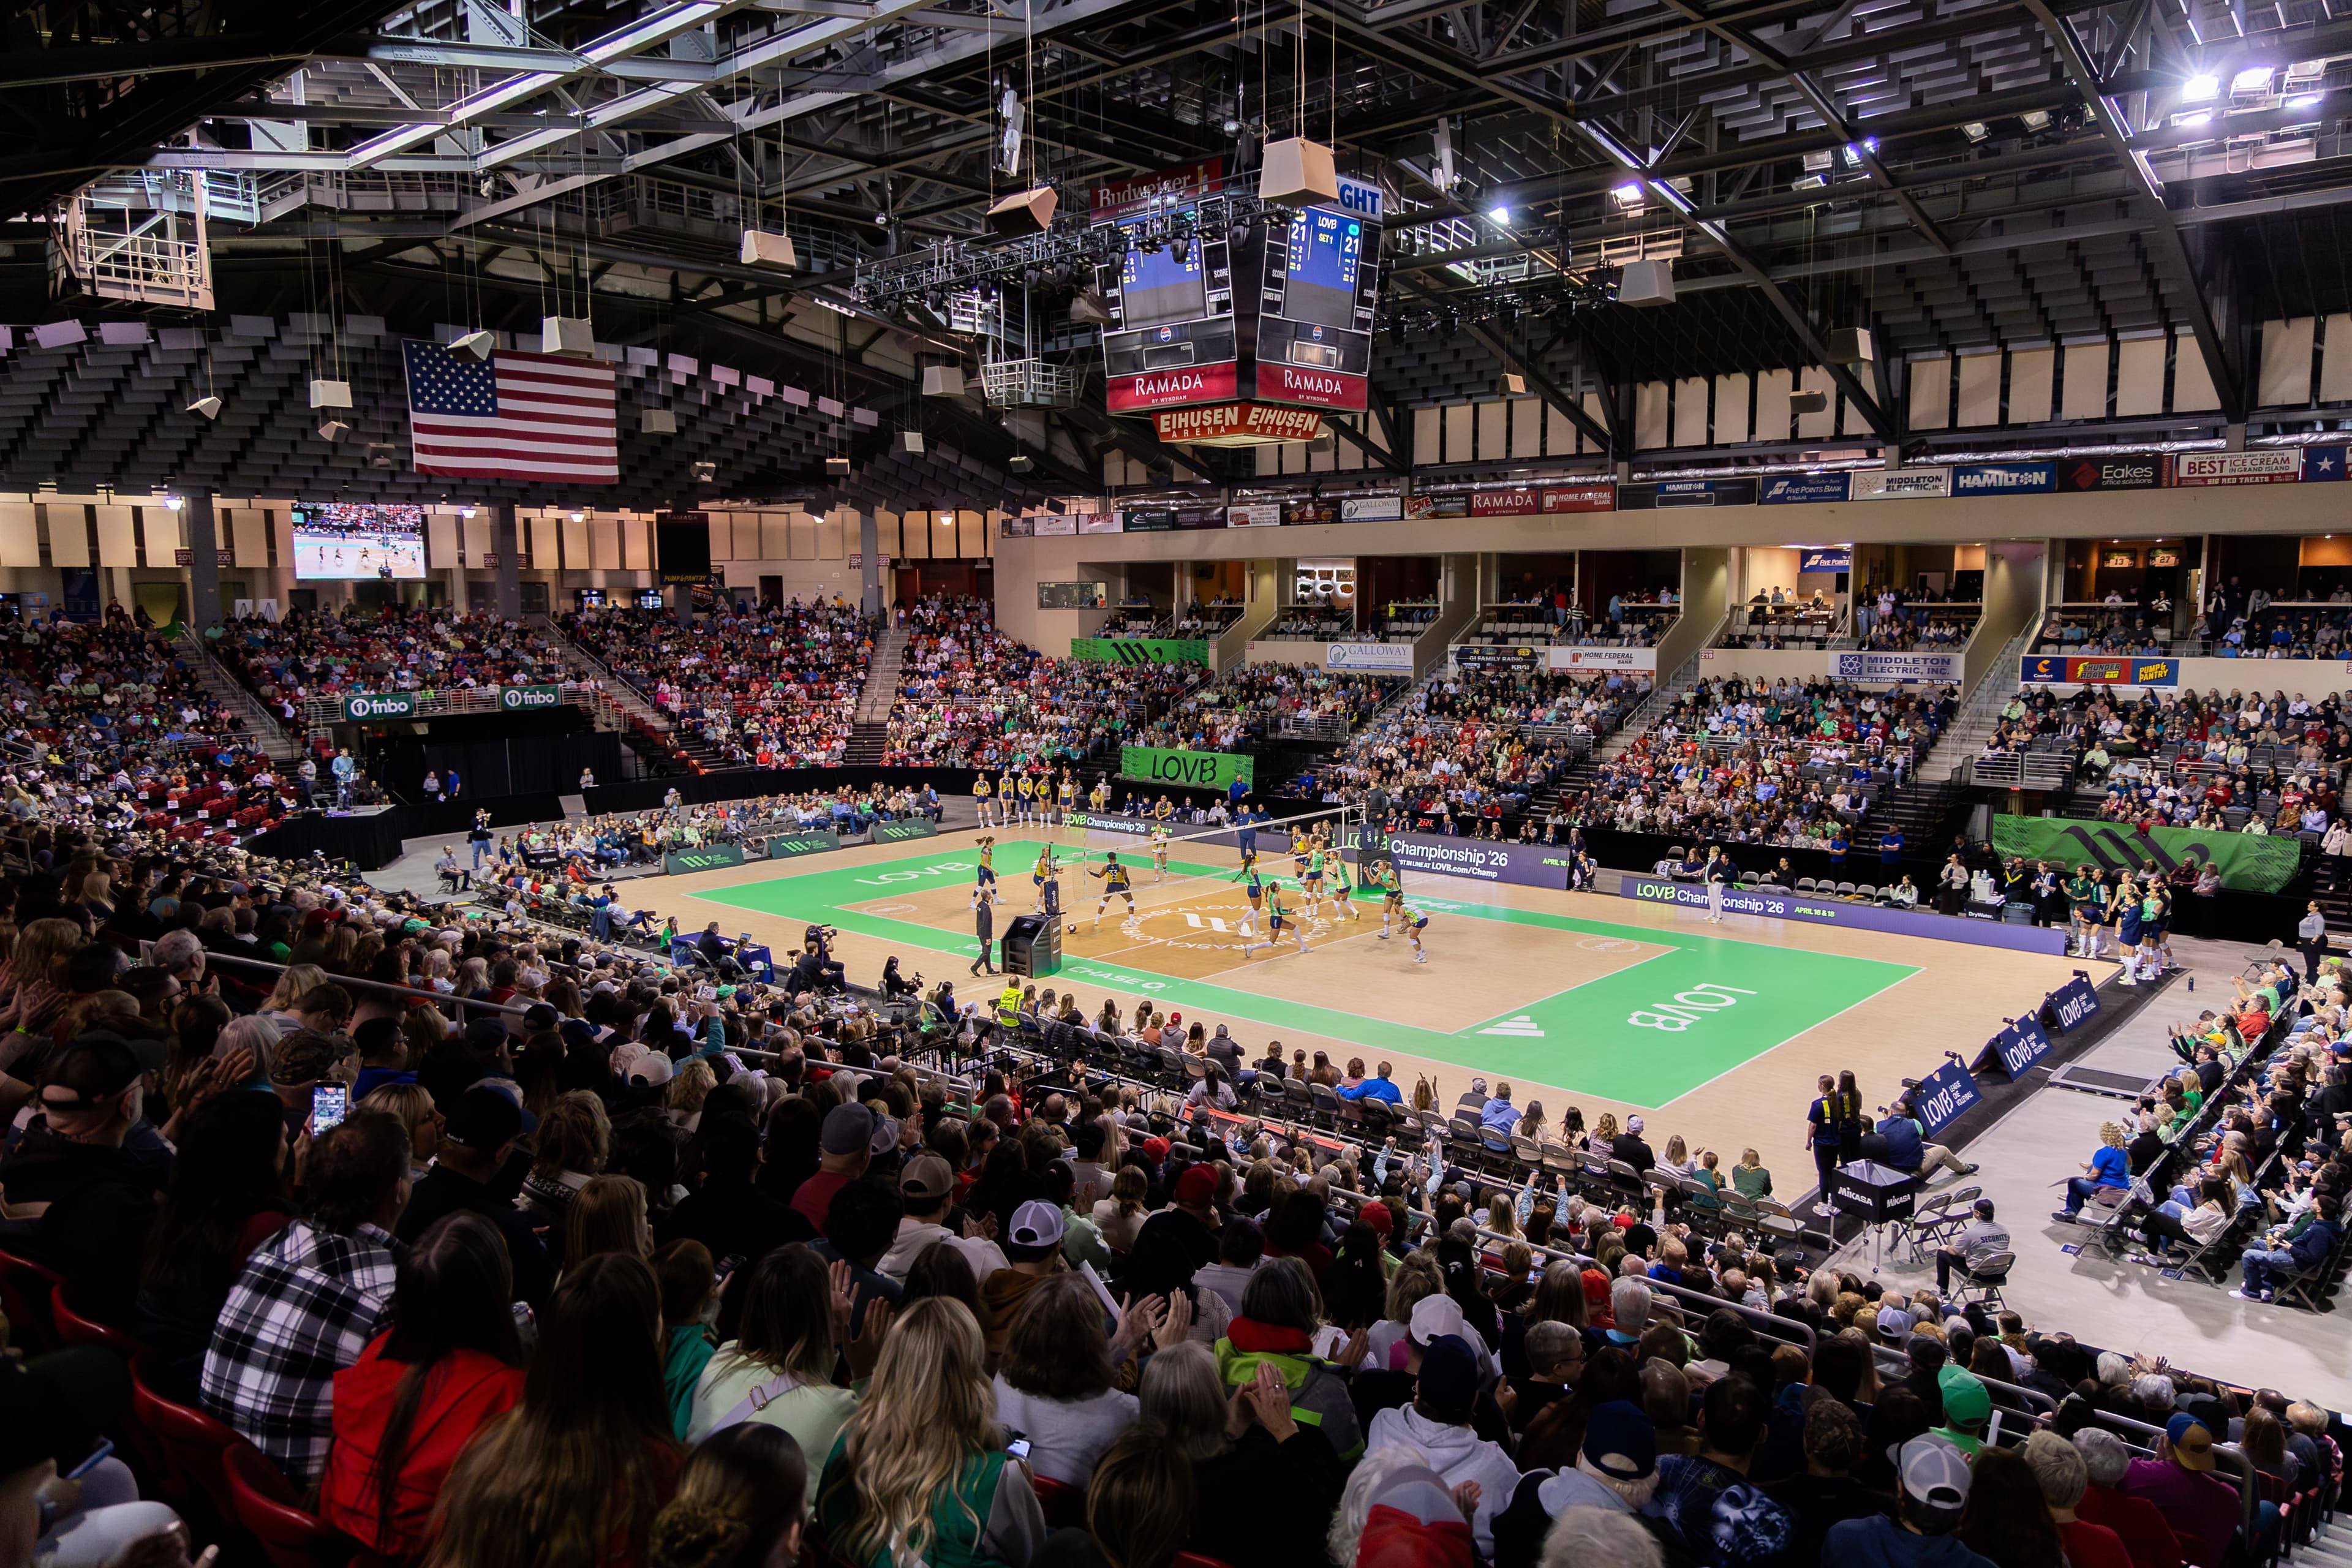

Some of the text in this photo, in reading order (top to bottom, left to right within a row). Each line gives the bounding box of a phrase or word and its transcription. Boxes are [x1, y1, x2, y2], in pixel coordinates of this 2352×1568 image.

[1337, 183, 1379, 215] GHT
[1318, 216, 1337, 230] LOVB
[1291, 223, 1306, 241] 21
[1319, 233, 1329, 243] SET
[1344, 236, 1359, 255] 21
[1214, 268, 1229, 277] SCORE
[1272, 270, 1284, 279] SCORE
[1106, 288, 1120, 297] SCORE
[1208, 293, 1220, 303] GAMES
[1264, 292, 1273, 300] GAMES
[1363, 288, 1374, 298] SCORE
[1136, 374, 1203, 396] RAMADA
[1284, 369, 1342, 395] RAMADA
[1159, 407, 1238, 432] EIHUSEN
[1246, 406, 1319, 432] EIHUSEN
[2102, 464, 2154, 479] Eakes
[2187, 460, 2226, 475] BEST
[2251, 456, 2290, 466] CREAM
[1886, 475, 1942, 484] MIDDLETON
[1473, 494, 1534, 508] RAMADA
[1580, 491, 1611, 500] FEDERAL
[1359, 498, 1400, 509] GALLOWAY
[1406, 496, 1434, 516] LOVE
[1348, 645, 1408, 657] GALLOWAY
[1868, 657, 1951, 666] MIDDLETON
[2081, 663, 2121, 671] THUNDER
[1867, 666, 1923, 676] ELECTRIC,
[2139, 669, 2169, 683] PANTRY
[522, 690, 555, 704] fnbo
[371, 699, 409, 714] fnbo
[1152, 755, 1216, 786] LOVB
[1087, 816, 1135, 832] Championship
[1390, 839, 1486, 865] Championship
[854, 862, 976, 885] LOVB
[1431, 862, 1498, 878] LOVB.com/Champ
[1637, 883, 1764, 914] LOVB Chamionship
[1794, 906, 1814, 916] APRIL
[1068, 966, 1141, 985] CHASE
[1627, 982, 1758, 1032] LOVB
[2059, 997, 2082, 1027] LOVB
[2005, 1038, 2032, 1072] LOVB
[1948, 1080, 1962, 1093] LEAGUE
[1952, 1090, 1961, 1100] ONE
[1955, 1091, 1974, 1107] VOLLEYBALL
[1922, 1087, 1954, 1127] LOVB
[1980, 1234, 2010, 1244] SECURITY
